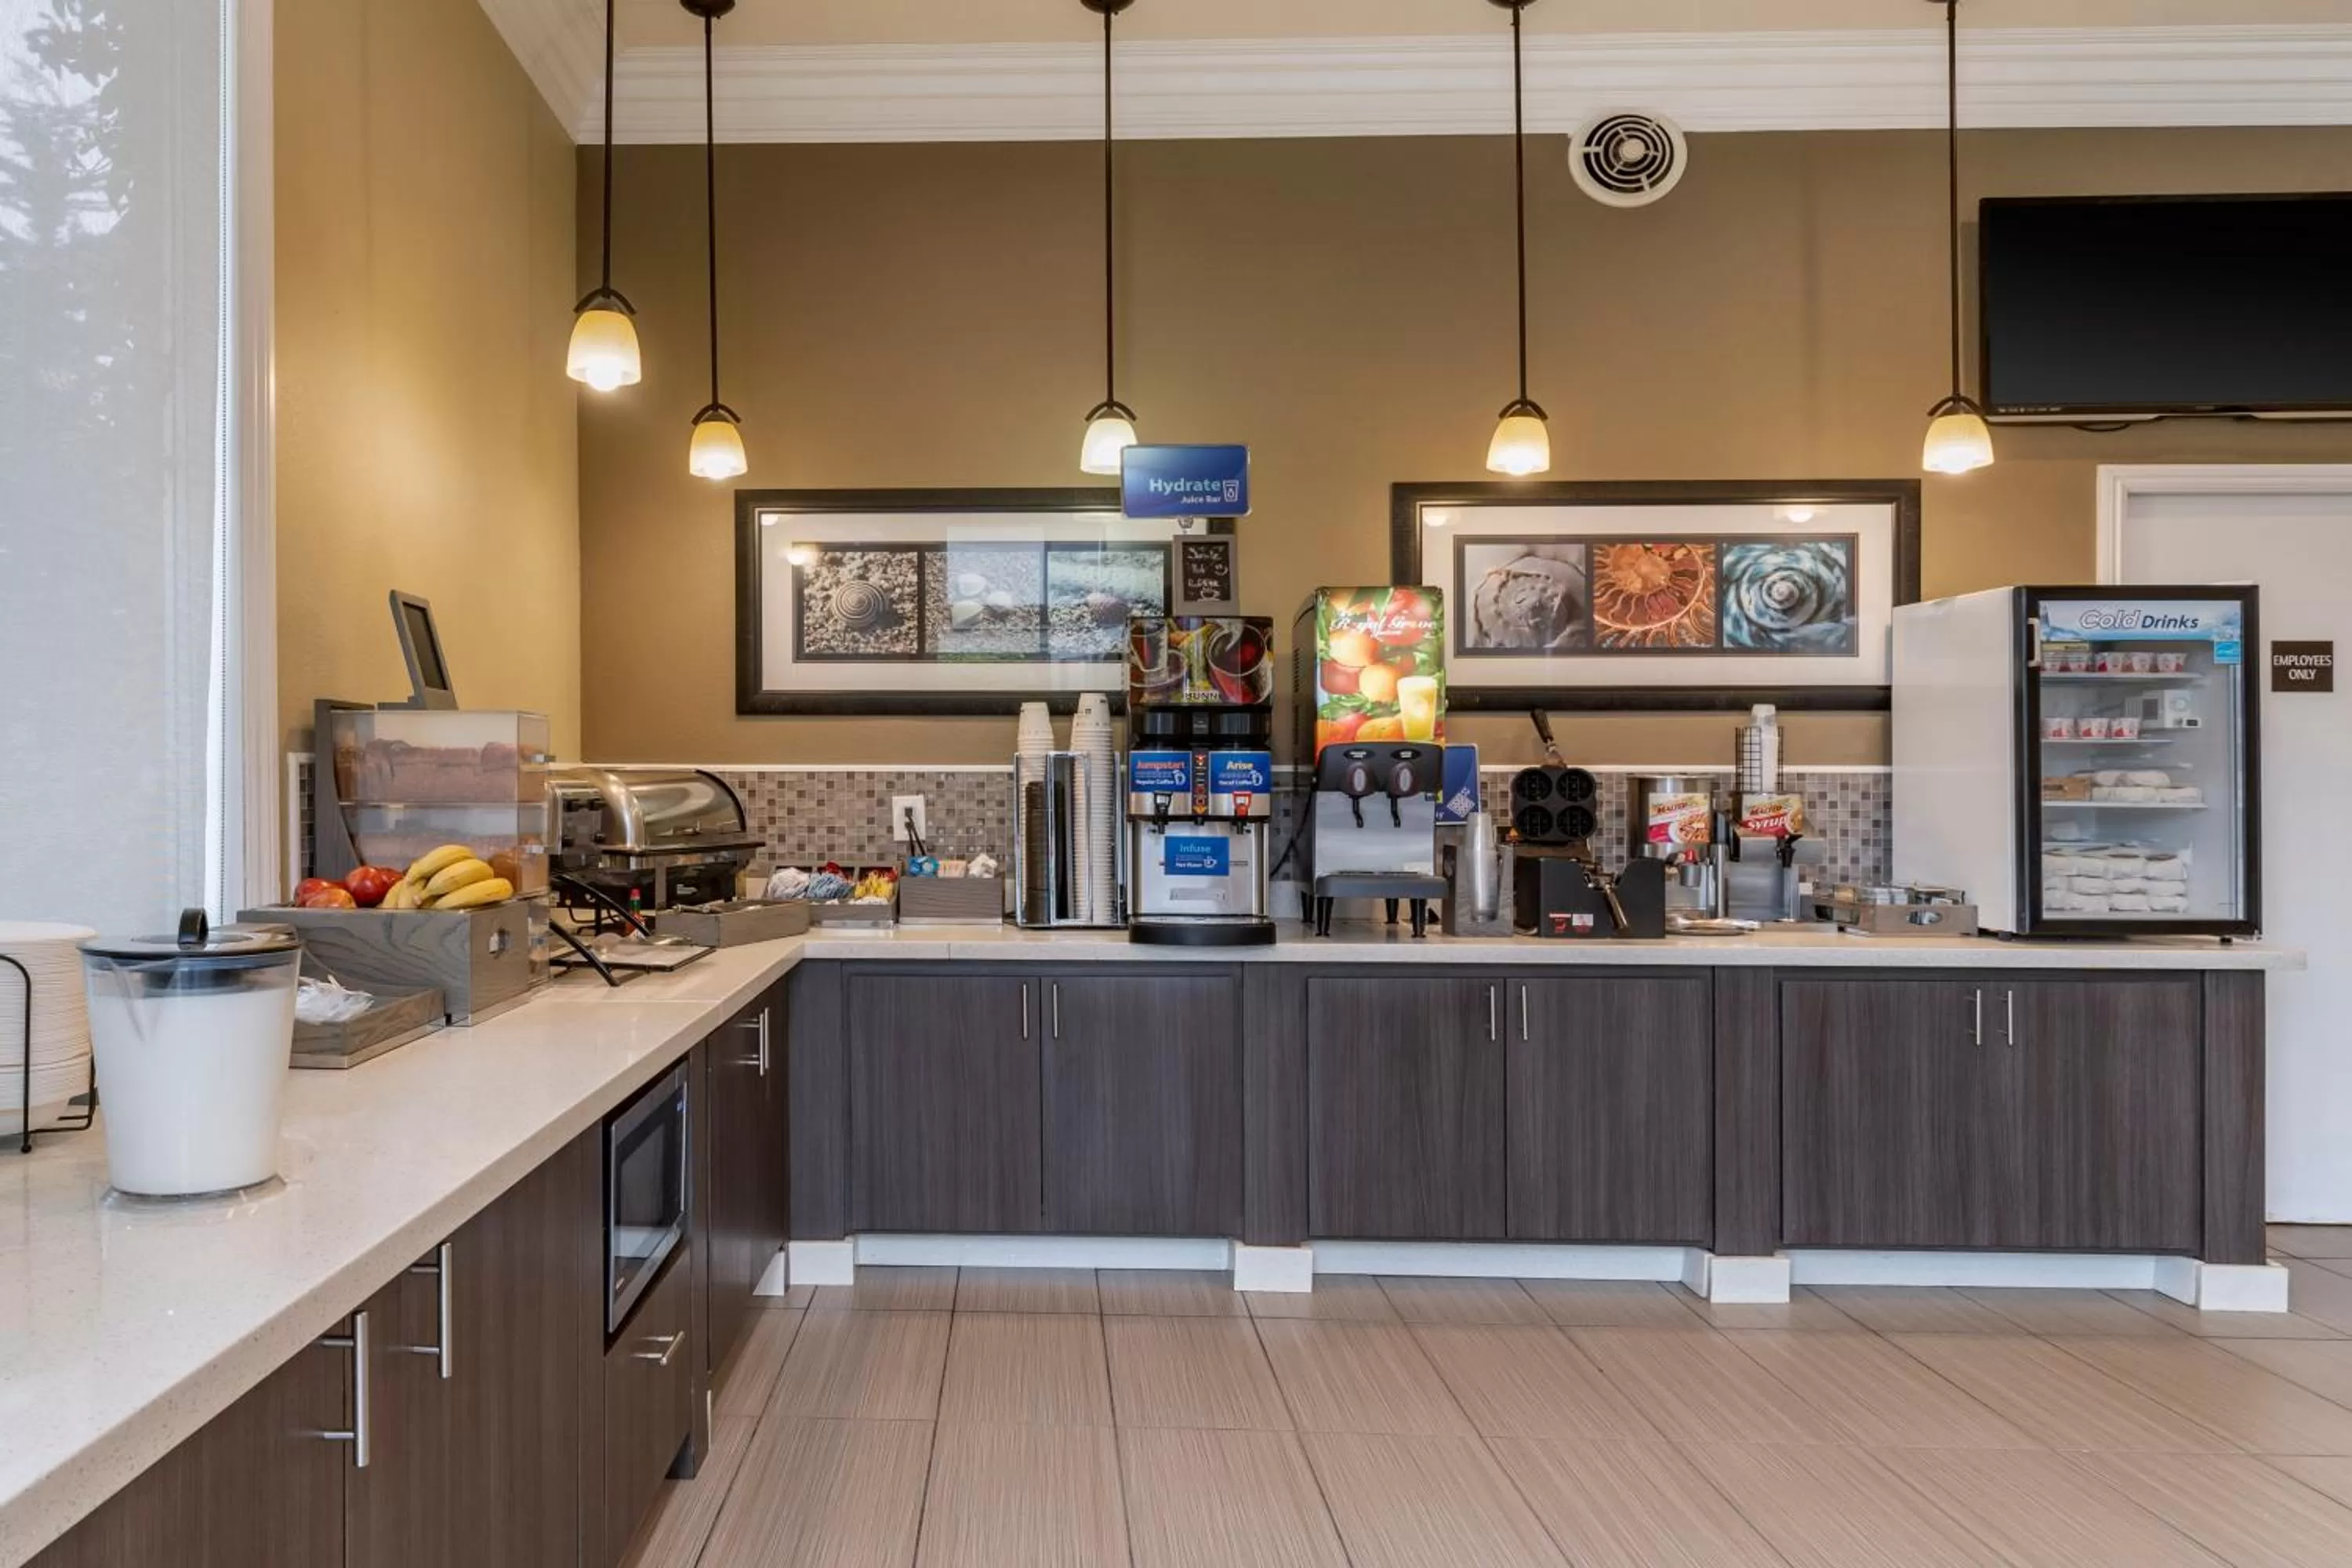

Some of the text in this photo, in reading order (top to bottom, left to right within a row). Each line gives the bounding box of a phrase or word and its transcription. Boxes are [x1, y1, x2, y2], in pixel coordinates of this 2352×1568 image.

[1149, 477, 1221, 495] Hydrate
[1181, 495, 1203, 504] Juice
[2080, 609, 2199, 630] Cold Drinks
[2273, 655, 2332, 666] EMPLOYEES
[2288, 669, 2317, 680] ONLY
[1184, 690, 1221, 703] BUNN
[1227, 760, 1254, 771] Arise
[1180, 844, 1211, 854] Infuse
